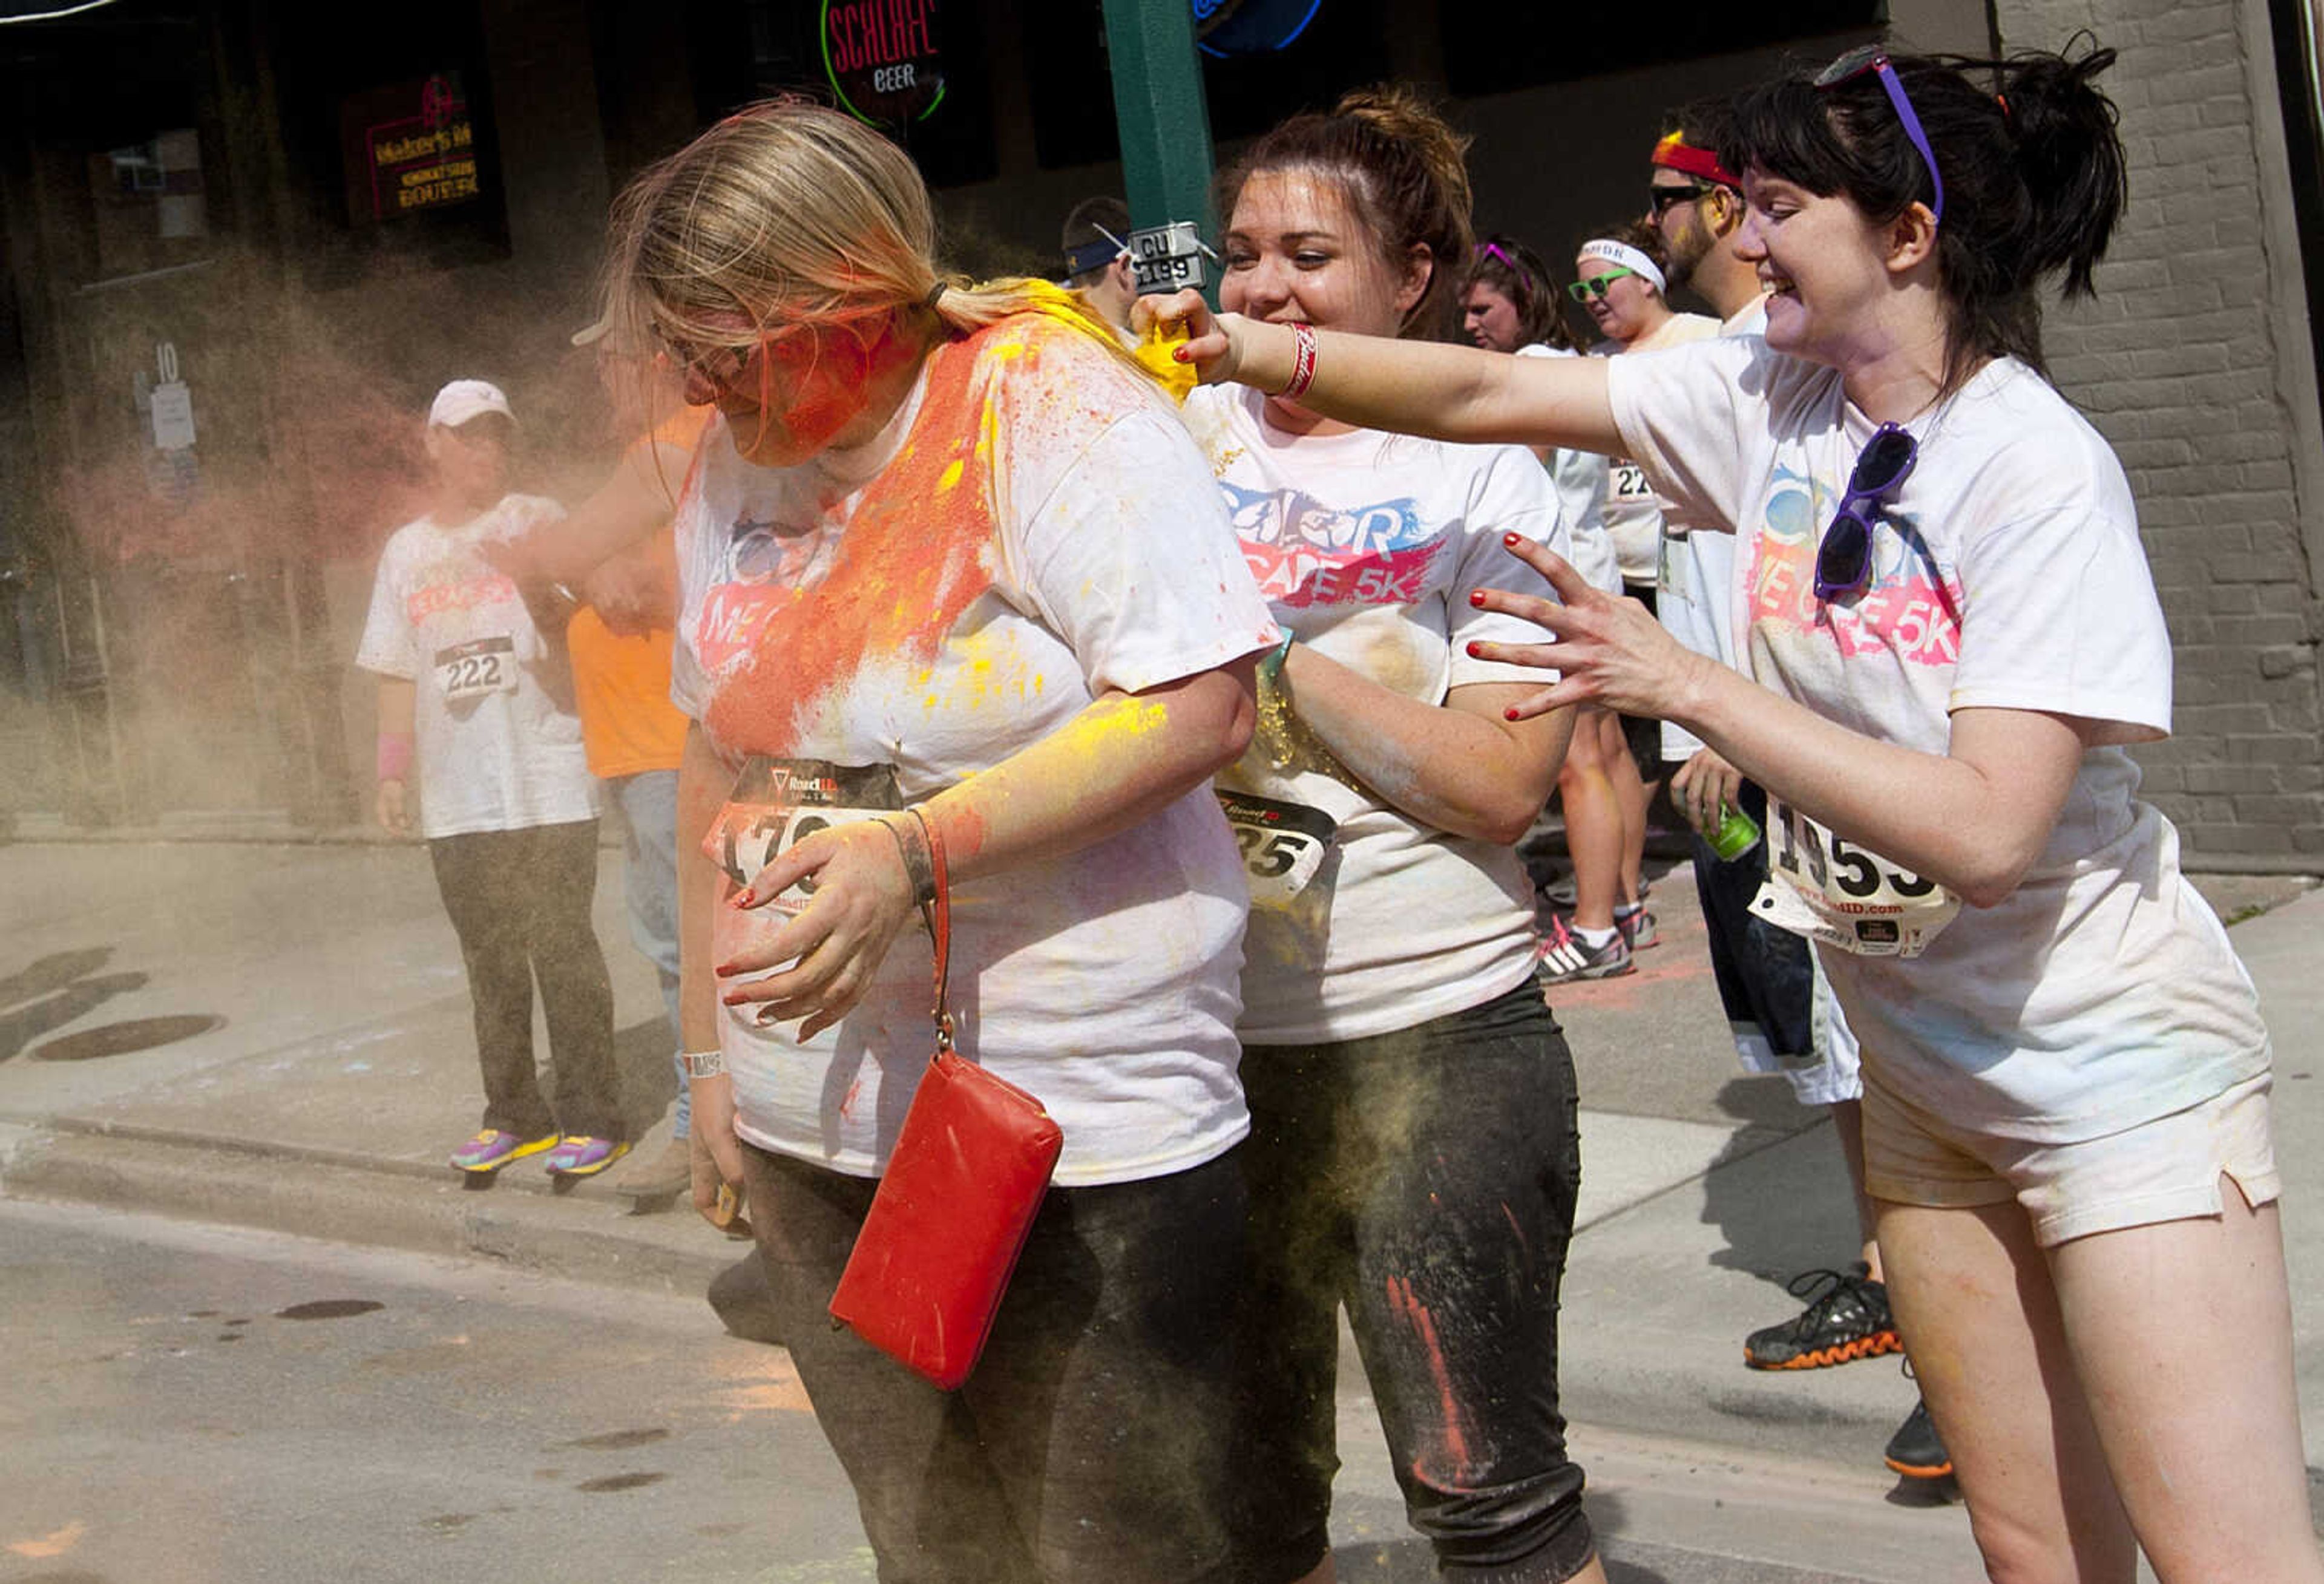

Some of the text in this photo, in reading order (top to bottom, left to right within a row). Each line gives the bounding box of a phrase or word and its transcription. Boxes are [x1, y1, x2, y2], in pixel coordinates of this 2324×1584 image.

[874, 63, 916, 93] BEER
[1141, 234, 1169, 258] CU
[1352, 568, 1411, 600] 5K
[1892, 600, 1958, 661] 5K
[447, 655, 502, 694] 222
